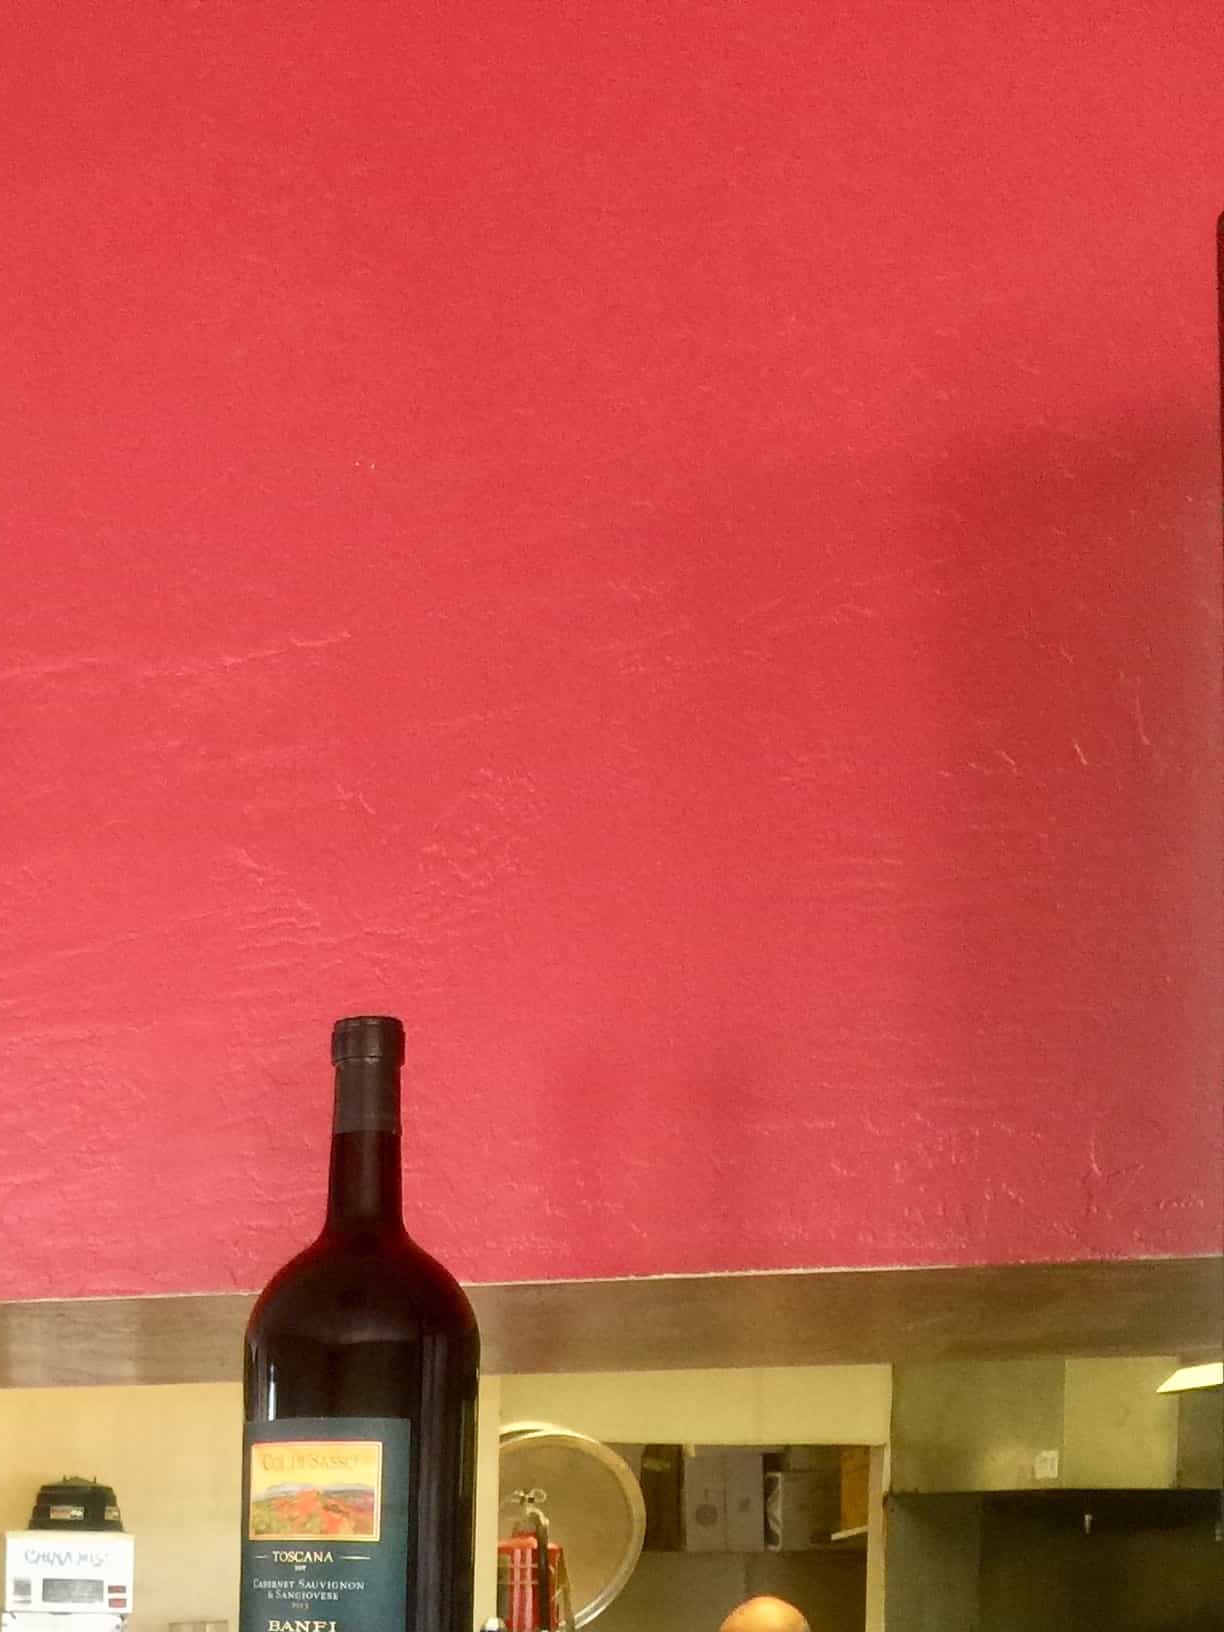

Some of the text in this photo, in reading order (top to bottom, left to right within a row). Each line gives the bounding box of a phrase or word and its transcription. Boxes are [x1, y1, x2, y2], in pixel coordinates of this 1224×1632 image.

[272, 1550, 334, 1563] TOSCANA
[253, 1579, 365, 1591] CABERNET SAUVIGNON
[275, 1590, 339, 1600] SANGIOVESE
[268, 1620, 337, 1632] BANFI
